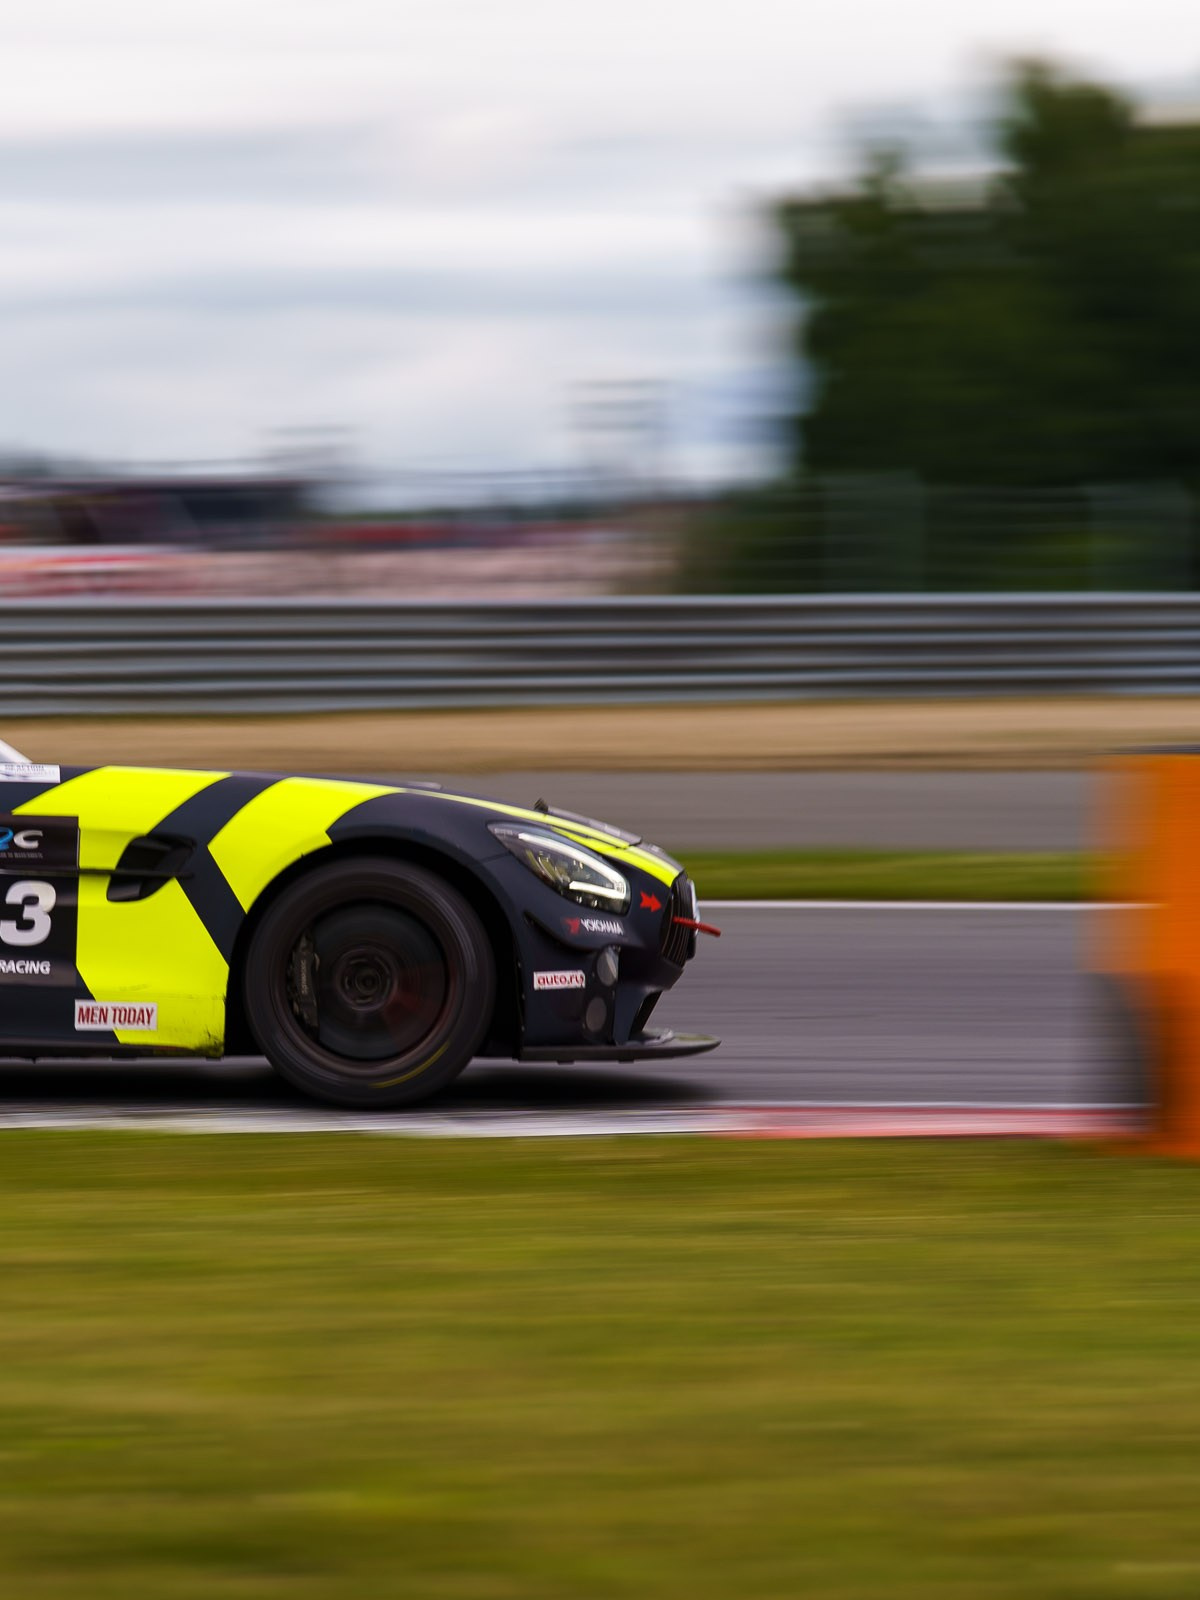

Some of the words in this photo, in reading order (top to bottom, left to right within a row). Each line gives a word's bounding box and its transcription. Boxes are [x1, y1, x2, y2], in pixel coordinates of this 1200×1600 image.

[580, 918, 623, 935] YOKOHAMA
[536, 973, 585, 986] auto.ru
[77, 1006, 108, 1025] MEN
[111, 1006, 154, 1026] TODAY
